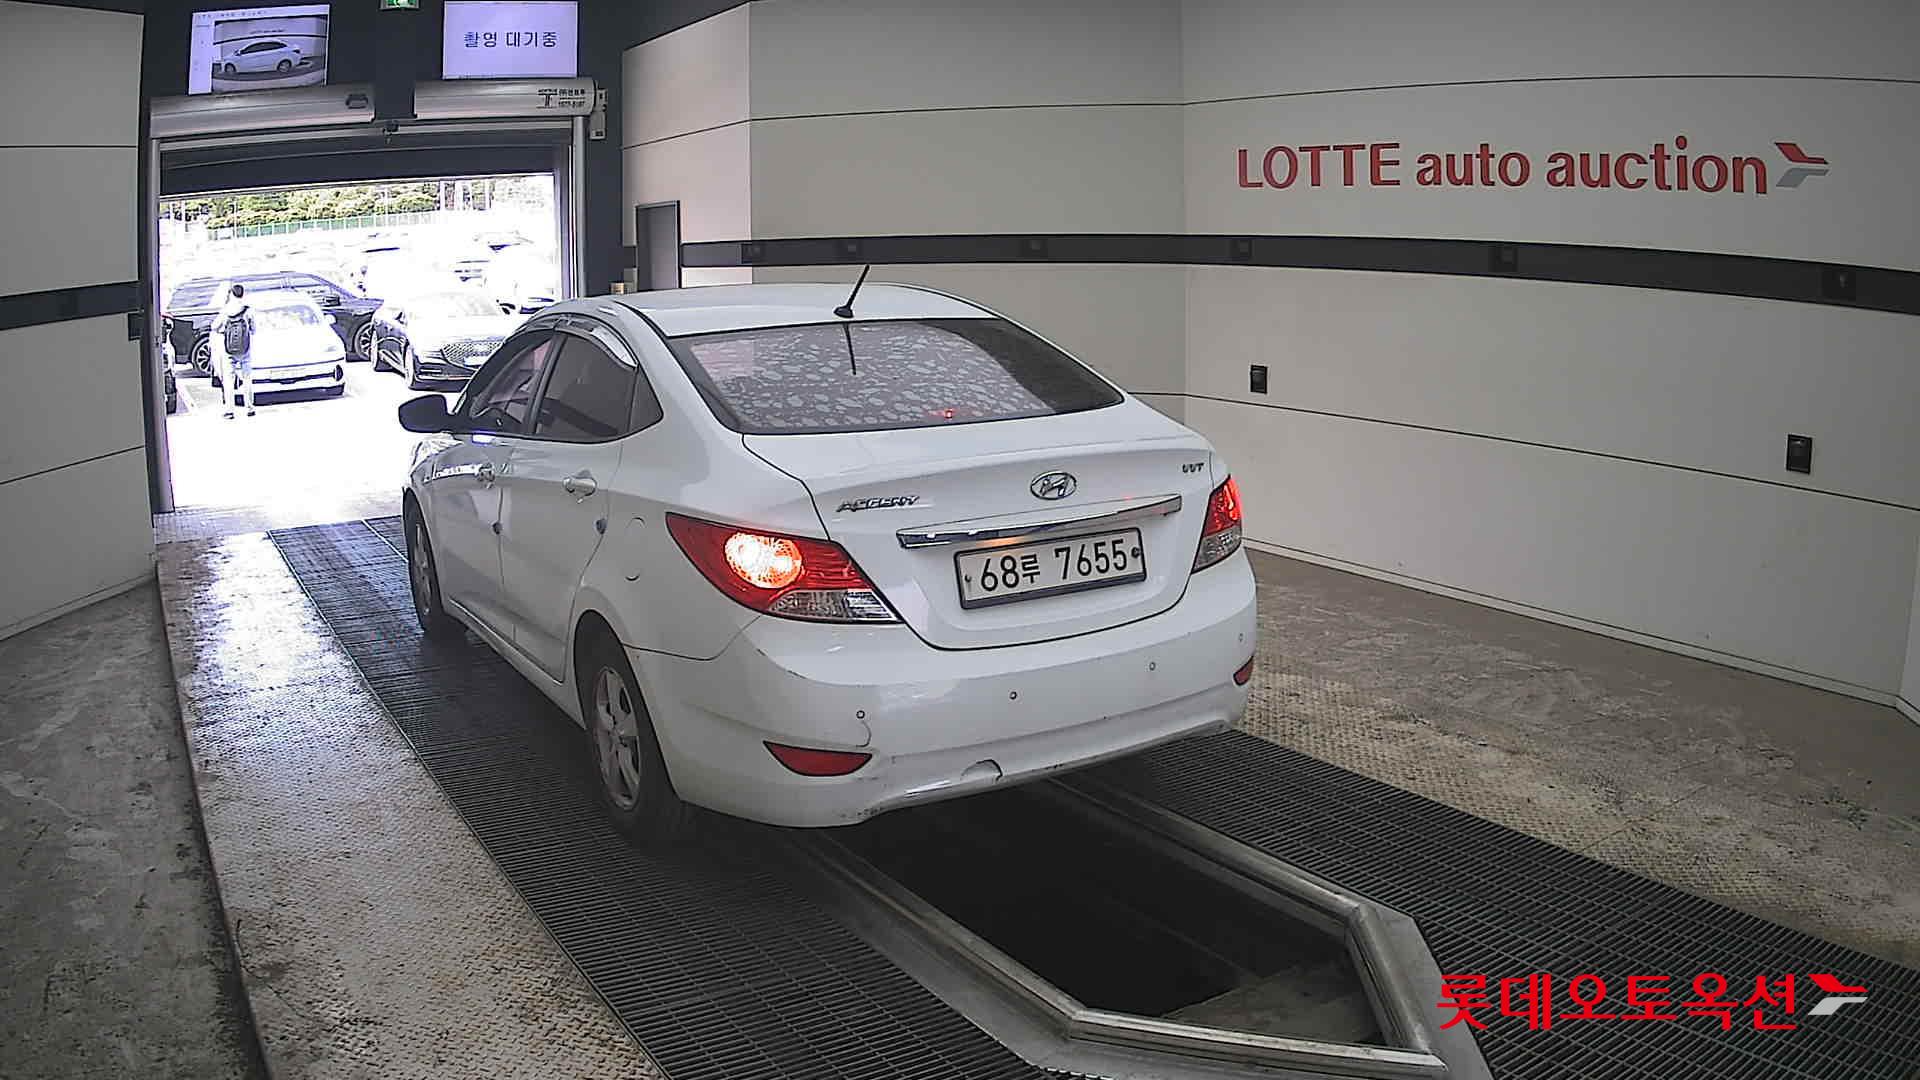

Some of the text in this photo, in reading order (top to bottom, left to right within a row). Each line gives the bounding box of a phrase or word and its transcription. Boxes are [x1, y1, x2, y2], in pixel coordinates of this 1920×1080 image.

[505, 31, 558, 48] 대기중
[1237, 136, 1768, 194] LOTTE auto auction
[980, 538, 1128, 592] 68루 7655
